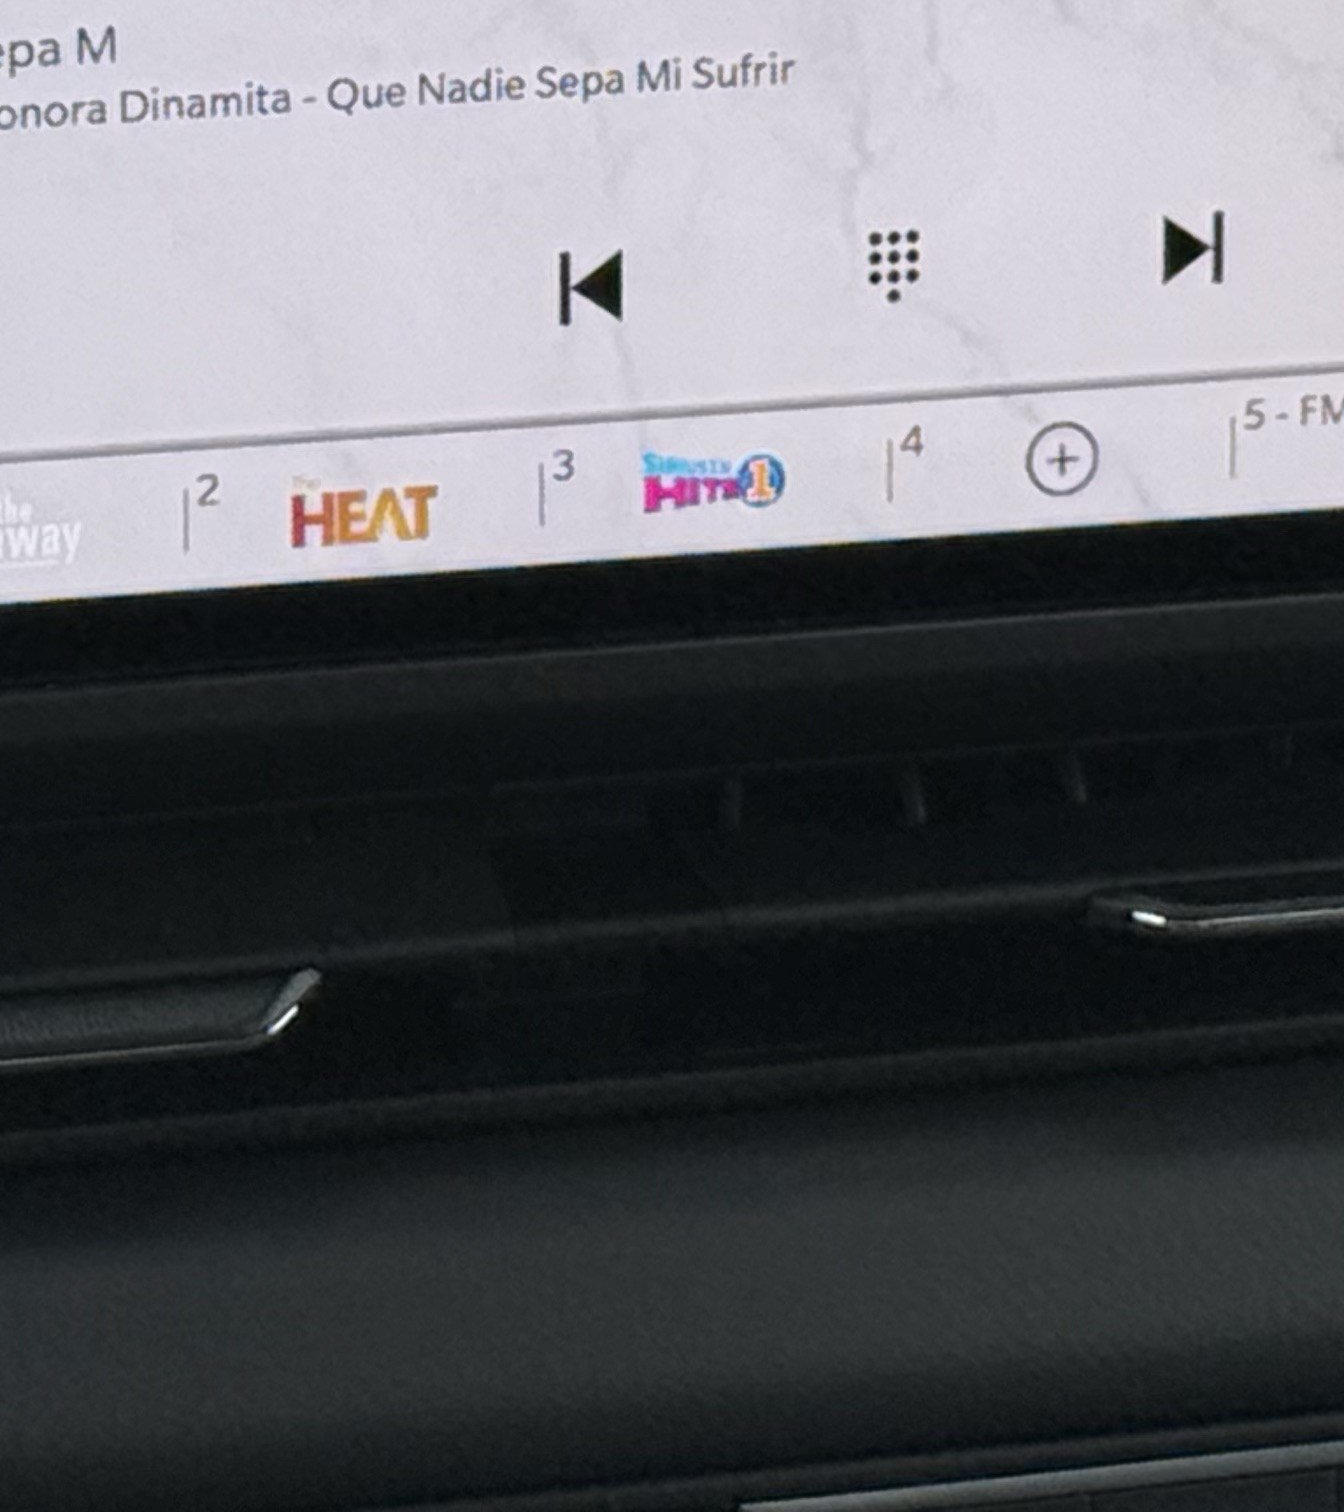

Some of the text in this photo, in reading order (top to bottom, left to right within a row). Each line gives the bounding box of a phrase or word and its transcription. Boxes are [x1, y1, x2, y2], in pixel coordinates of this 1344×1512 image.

[76, 25, 117, 65] M
[120, 80, 292, 124] Dinamita
[326, 78, 406, 115] Que
[418, 67, 526, 106] Nadie
[535, 65, 625, 104] Sepa
[636, 56, 682, 92] Mi
[692, 51, 798, 90] Sufrir
[1242, 399, 1266, 430] 5
[900, 425, 924, 457] 4
[553, 450, 575, 481] 3
[197, 474, 221, 506] 2
[290, 485, 438, 548] HEAT
